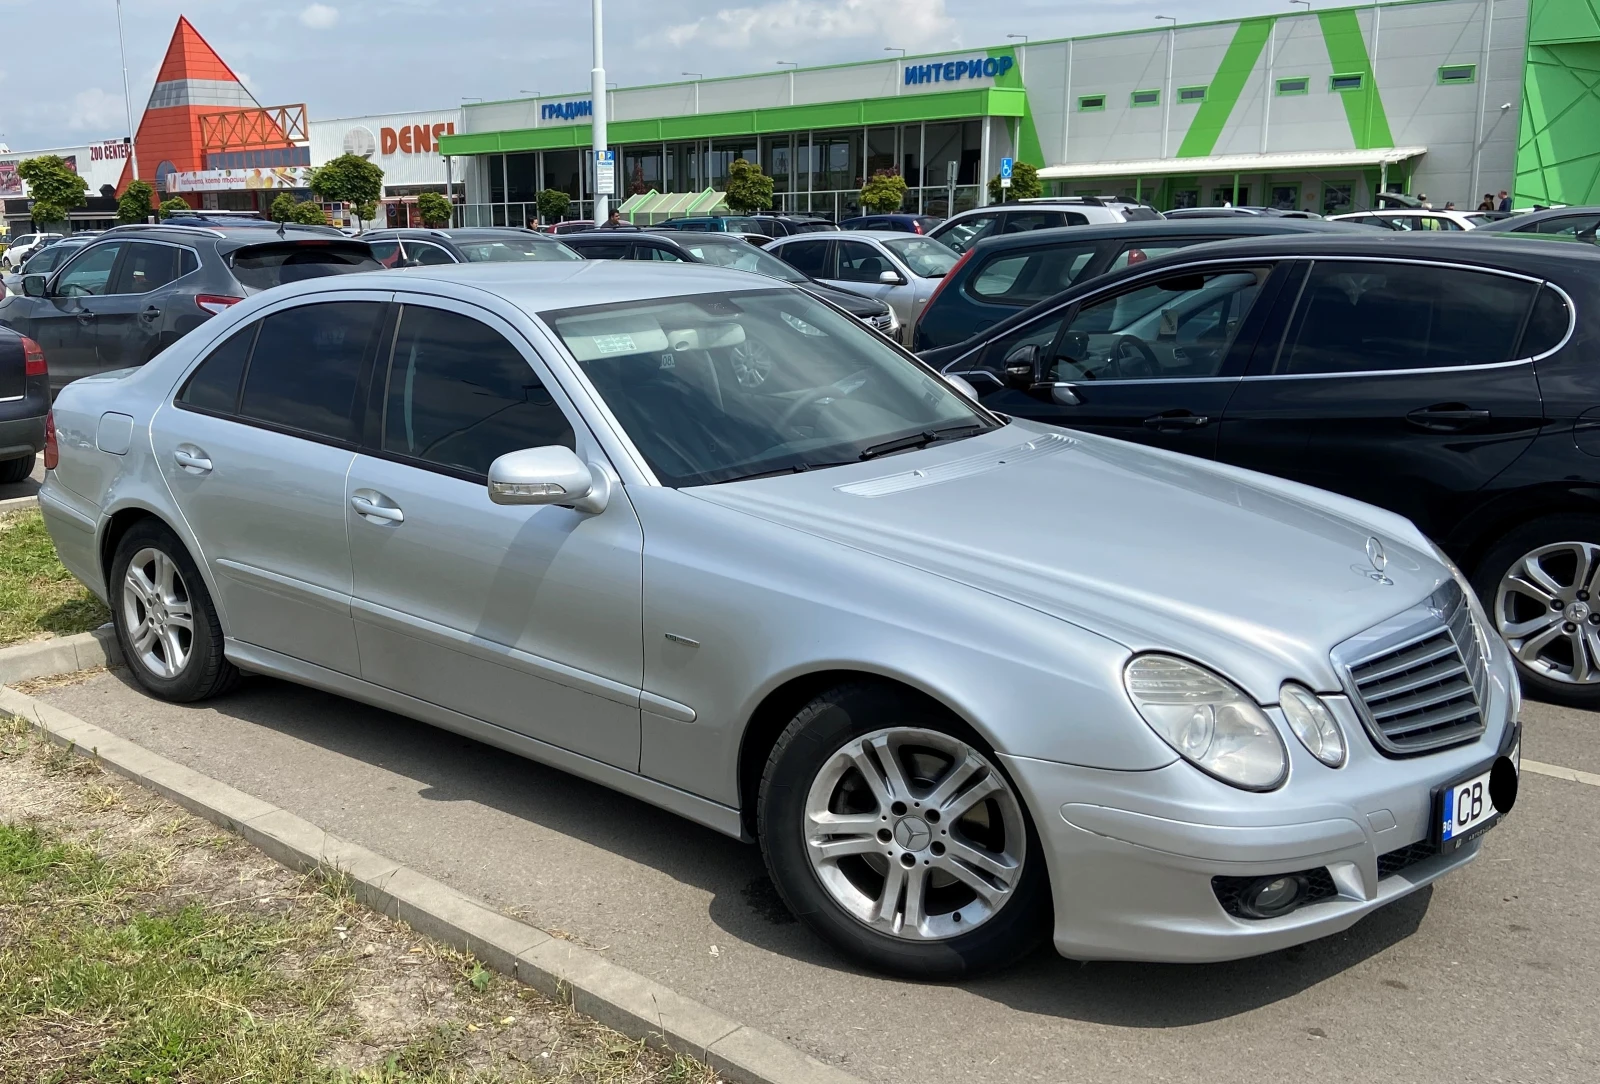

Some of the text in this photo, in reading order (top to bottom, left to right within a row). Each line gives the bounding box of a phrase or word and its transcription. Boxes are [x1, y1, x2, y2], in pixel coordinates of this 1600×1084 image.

[905, 56, 1013, 85] ИНТЕРИОР
[541, 100, 592, 120] ГРАДИН
[90, 143, 130, 161] ZOO CENTER
[1443, 820, 1451, 833] BG
